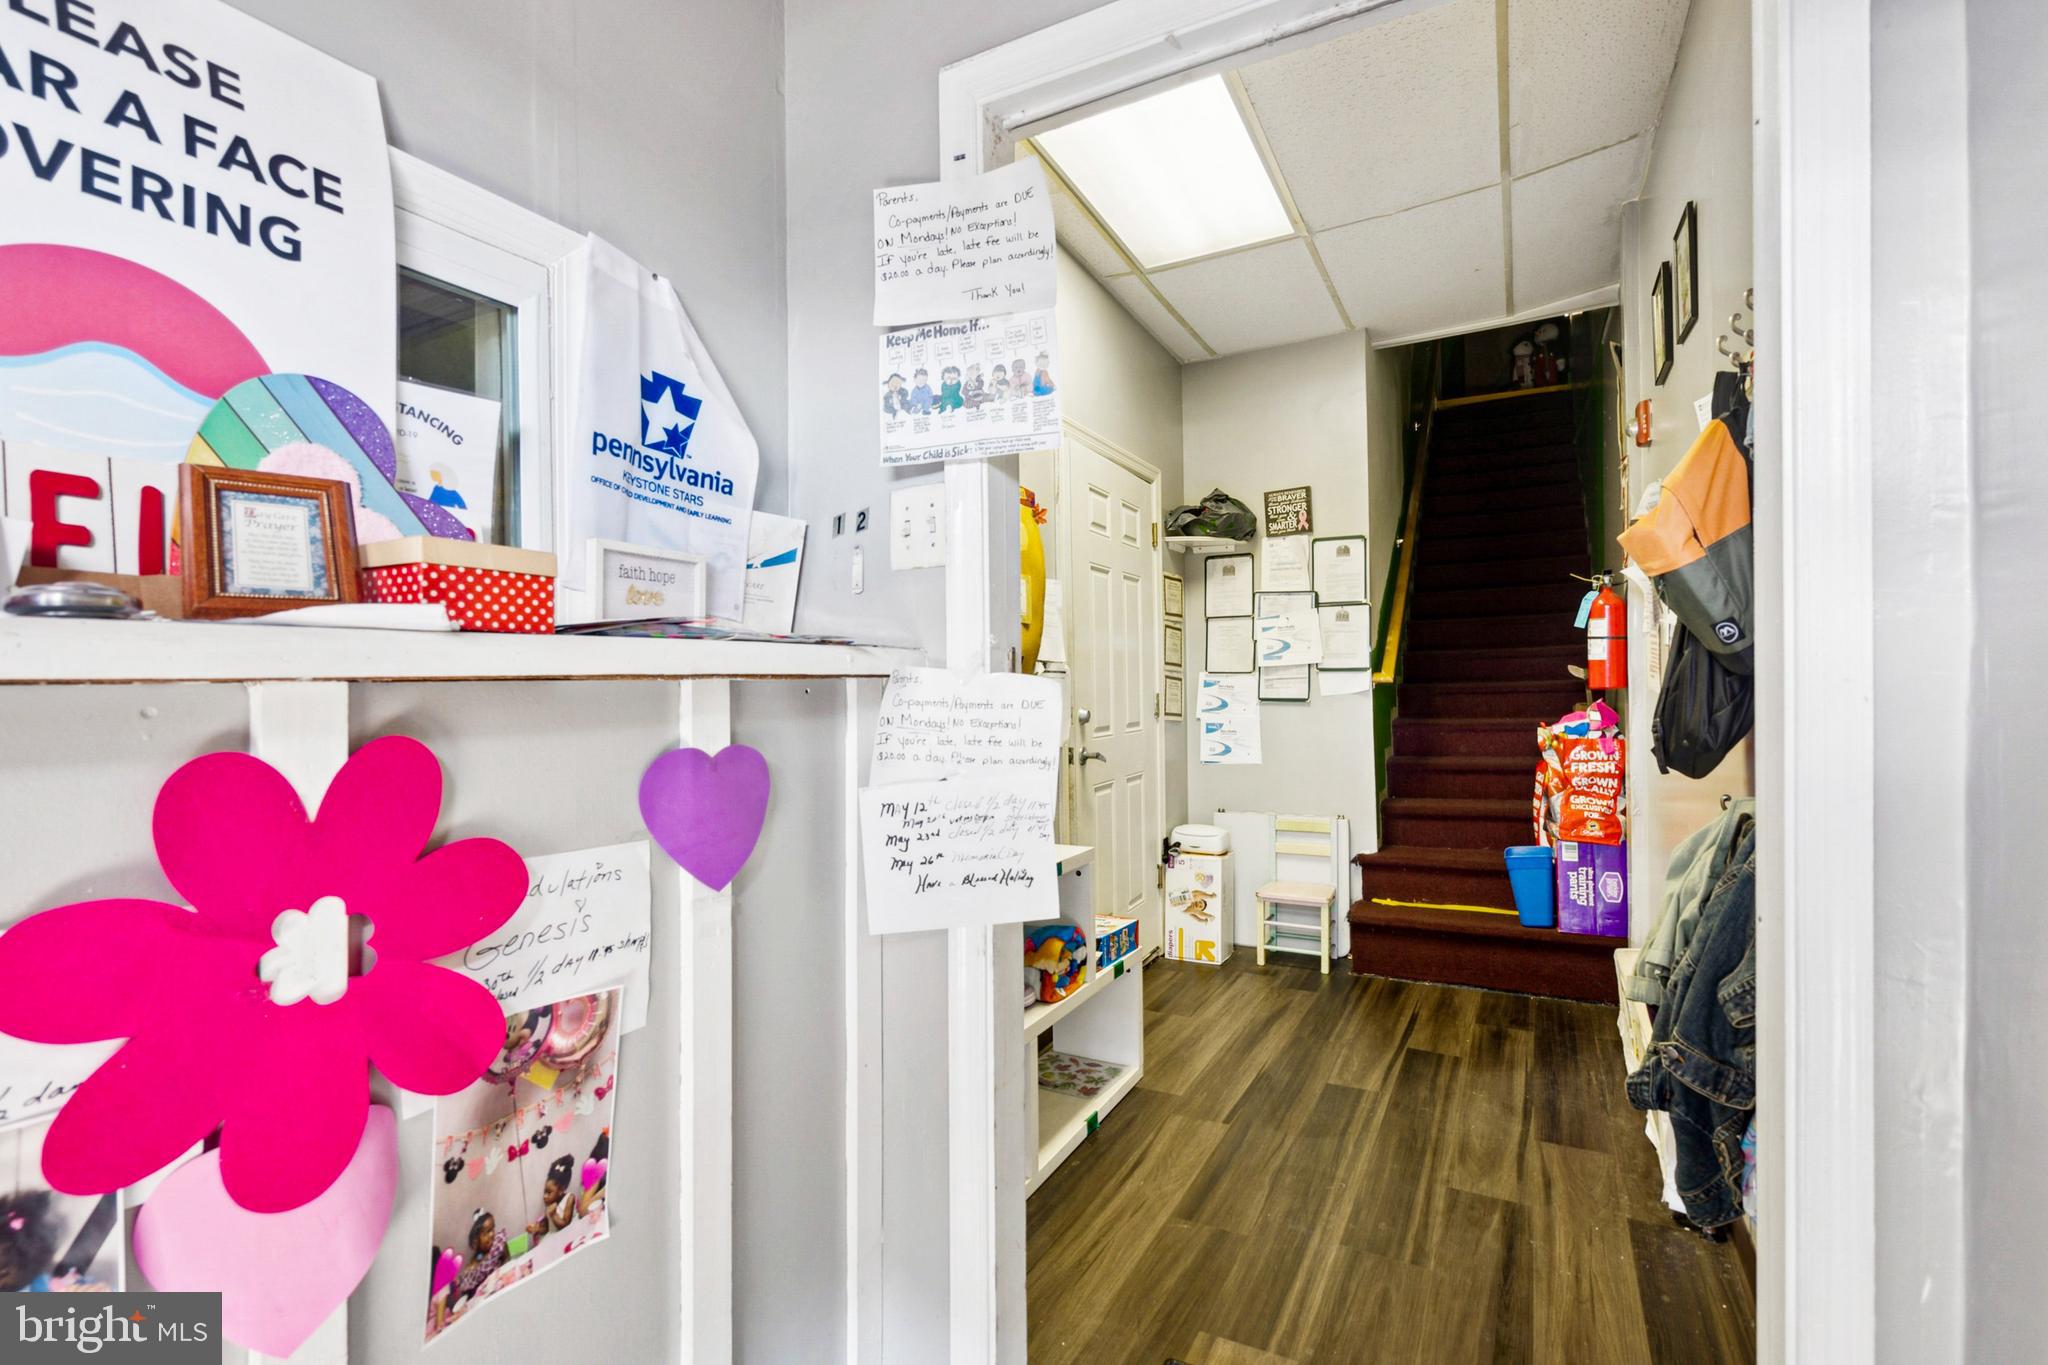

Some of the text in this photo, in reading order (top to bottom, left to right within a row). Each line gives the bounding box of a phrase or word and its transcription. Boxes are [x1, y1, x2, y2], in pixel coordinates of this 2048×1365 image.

[103, 90, 163, 145] A
[183, 114, 344, 215] FACE
[0, 121, 302, 262] VERING
[996, 201, 1008, 209] are
[1014, 187, 1034, 204] DUE
[963, 239, 981, 252] late
[1006, 234, 1023, 243] will
[1028, 230, 1040, 240] be
[952, 258, 976, 270] Please
[982, 255, 1002, 269] plan
[962, 282, 1025, 301] Thank You!
[886, 333, 915, 349] Keep
[915, 328, 933, 342] Me
[933, 323, 967, 339] Home
[592, 431, 734, 497] pennsylvania
[883, 454, 904, 465] When
[905, 452, 921, 463] Your
[922, 448, 943, 460] Child
[944, 450, 951, 458] is
[623, 470, 704, 507] KEYSTONE STARS
[1277, 492, 1307, 501] BRAVER
[591, 475, 612, 489] OFFICE
[613, 482, 621, 491] OF
[634, 493, 675, 510] DEVELOPMENT
[675, 505, 687, 514] AND
[687, 508, 704, 518] EARLY
[704, 513, 732, 525] LEARNING
[1267, 502, 1307, 515] STRONGER
[837, 511, 866, 535] 1 2
[1269, 521, 1297, 531] SMARTER
[618, 564, 676, 585] faith hope
[1021, 699, 1046, 710] DUE
[964, 736, 982, 746] late
[1009, 738, 1026, 747] will
[1031, 738, 1043, 747] be
[913, 753, 921, 761] a
[982, 755, 1003, 767] plan
[1570, 761, 1619, 774] FRESH.
[1571, 777, 1618, 788] GROWN
[886, 834, 910, 852] May
[891, 857, 913, 875] May
[1567, 871, 1578, 900] pants
[1576, 867, 1588, 906] training
[496, 987, 519, 1000] losed
